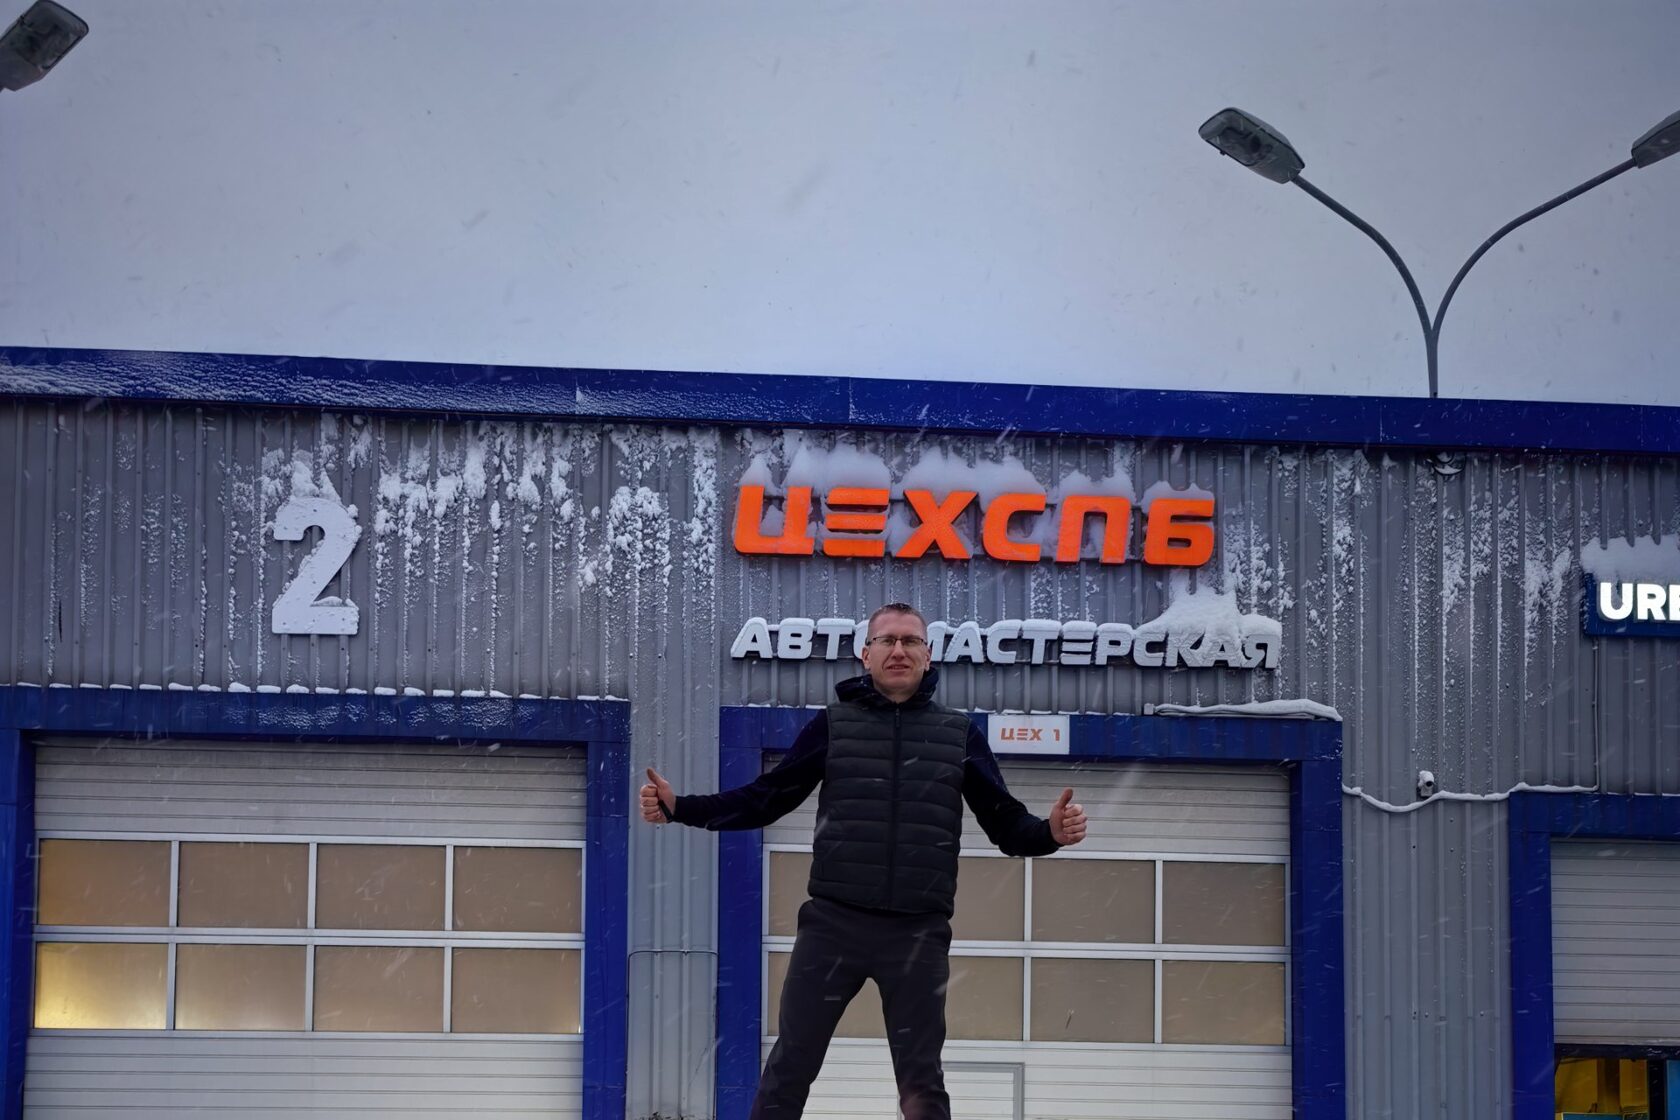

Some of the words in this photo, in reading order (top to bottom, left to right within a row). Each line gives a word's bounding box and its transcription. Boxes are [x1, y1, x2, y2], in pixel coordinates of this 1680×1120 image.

[734, 484, 1215, 566] ЦЕХСПБ
[271, 498, 360, 635] 2
[1000, 727, 1042, 741] ЦЕХ
[1053, 728, 1060, 742] 1
